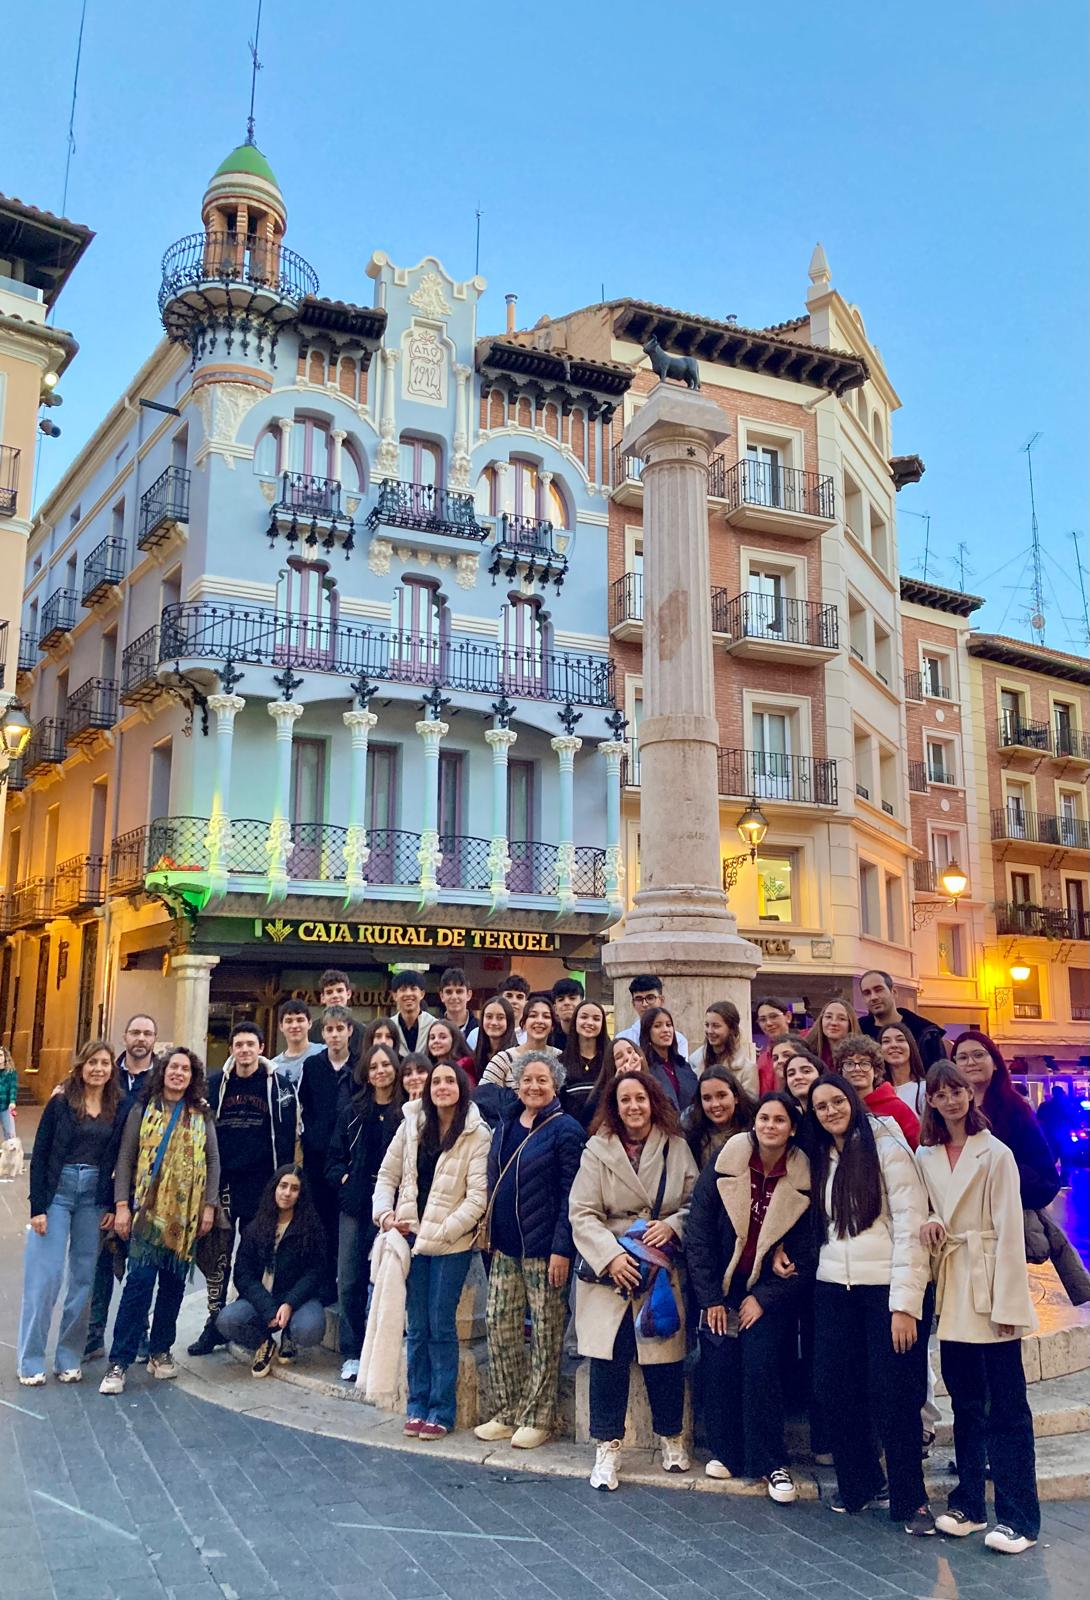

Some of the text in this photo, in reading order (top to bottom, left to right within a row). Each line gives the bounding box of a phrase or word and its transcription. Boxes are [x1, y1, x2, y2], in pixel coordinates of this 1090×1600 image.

[414, 366, 438, 388] 1912
[298, 921, 554, 951] CAJA RURAL DE TERUEL
